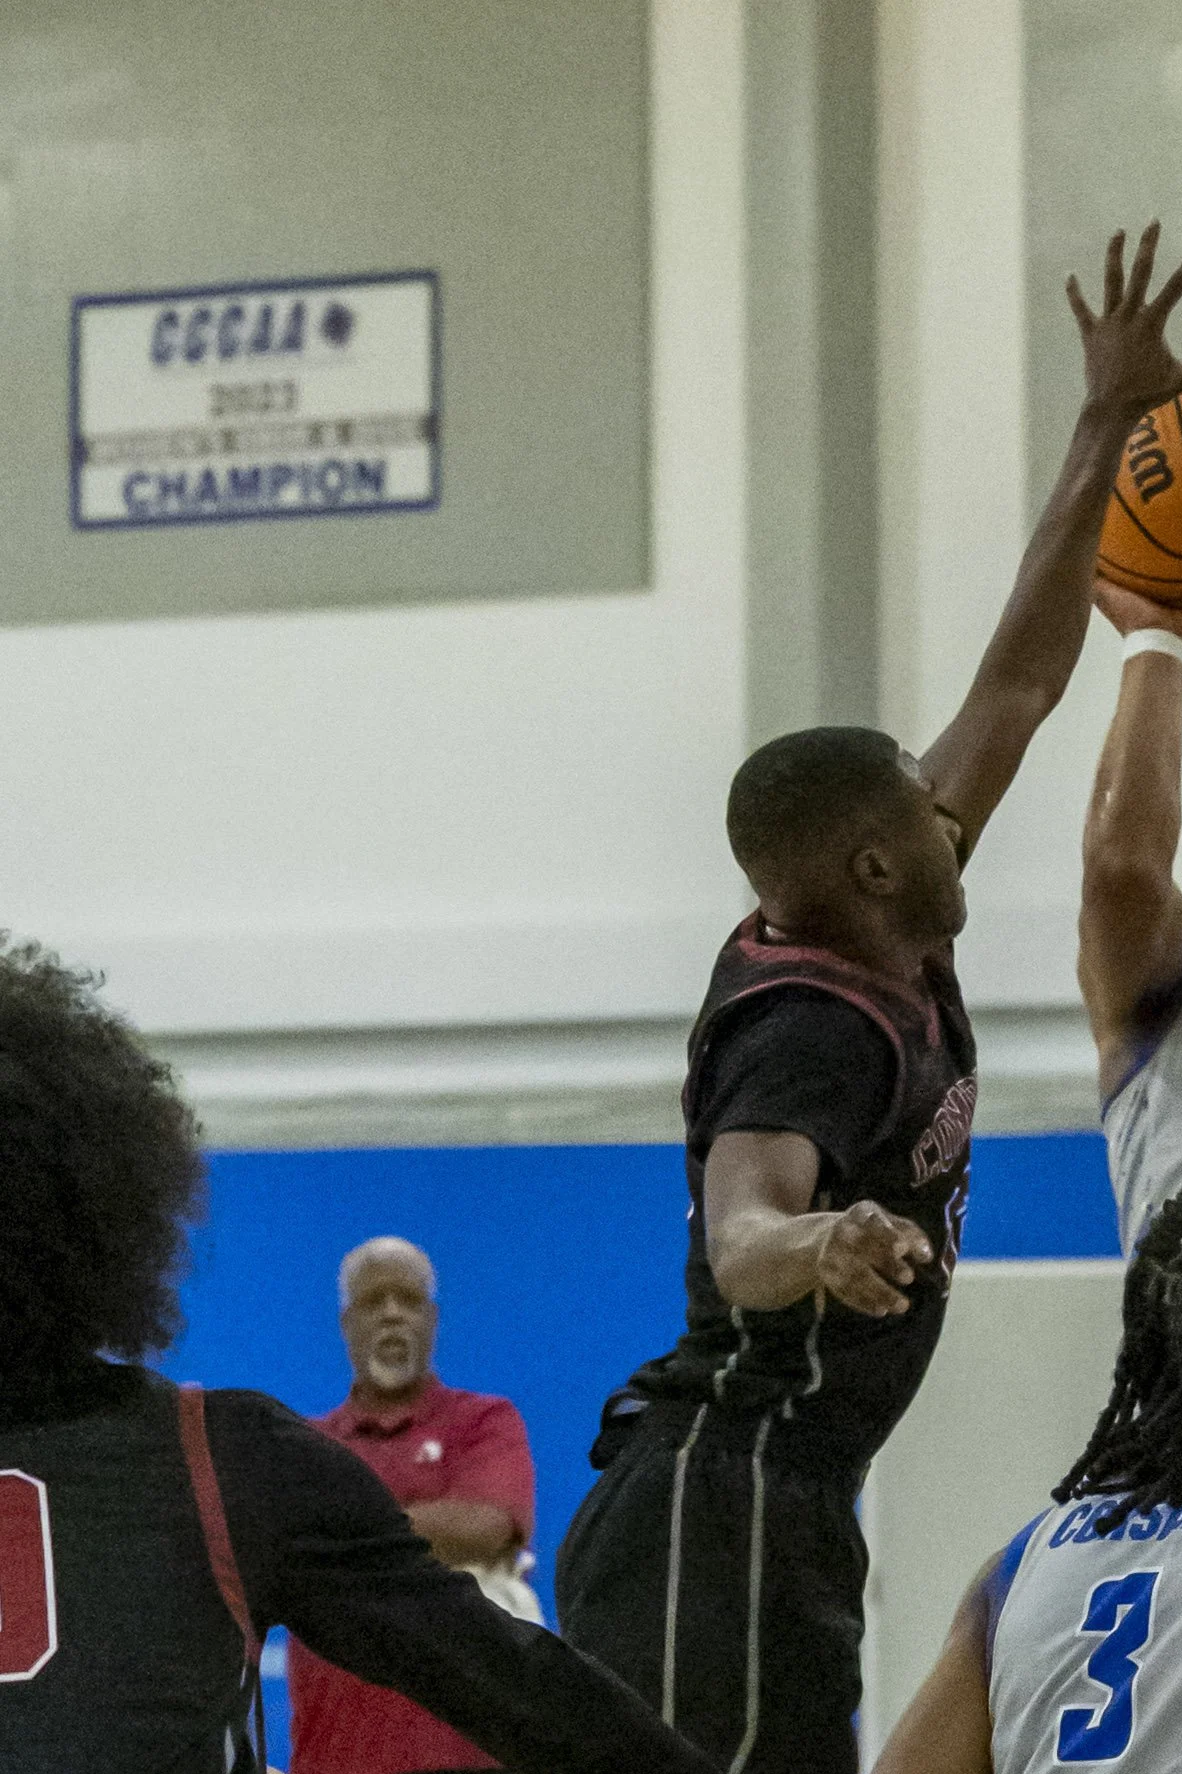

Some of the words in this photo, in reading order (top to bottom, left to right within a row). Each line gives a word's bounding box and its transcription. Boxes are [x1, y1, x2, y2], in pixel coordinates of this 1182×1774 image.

[151, 299, 304, 366] CCCAA
[122, 457, 388, 516] CHAMPION
[1053, 1566, 1164, 1767] 3
